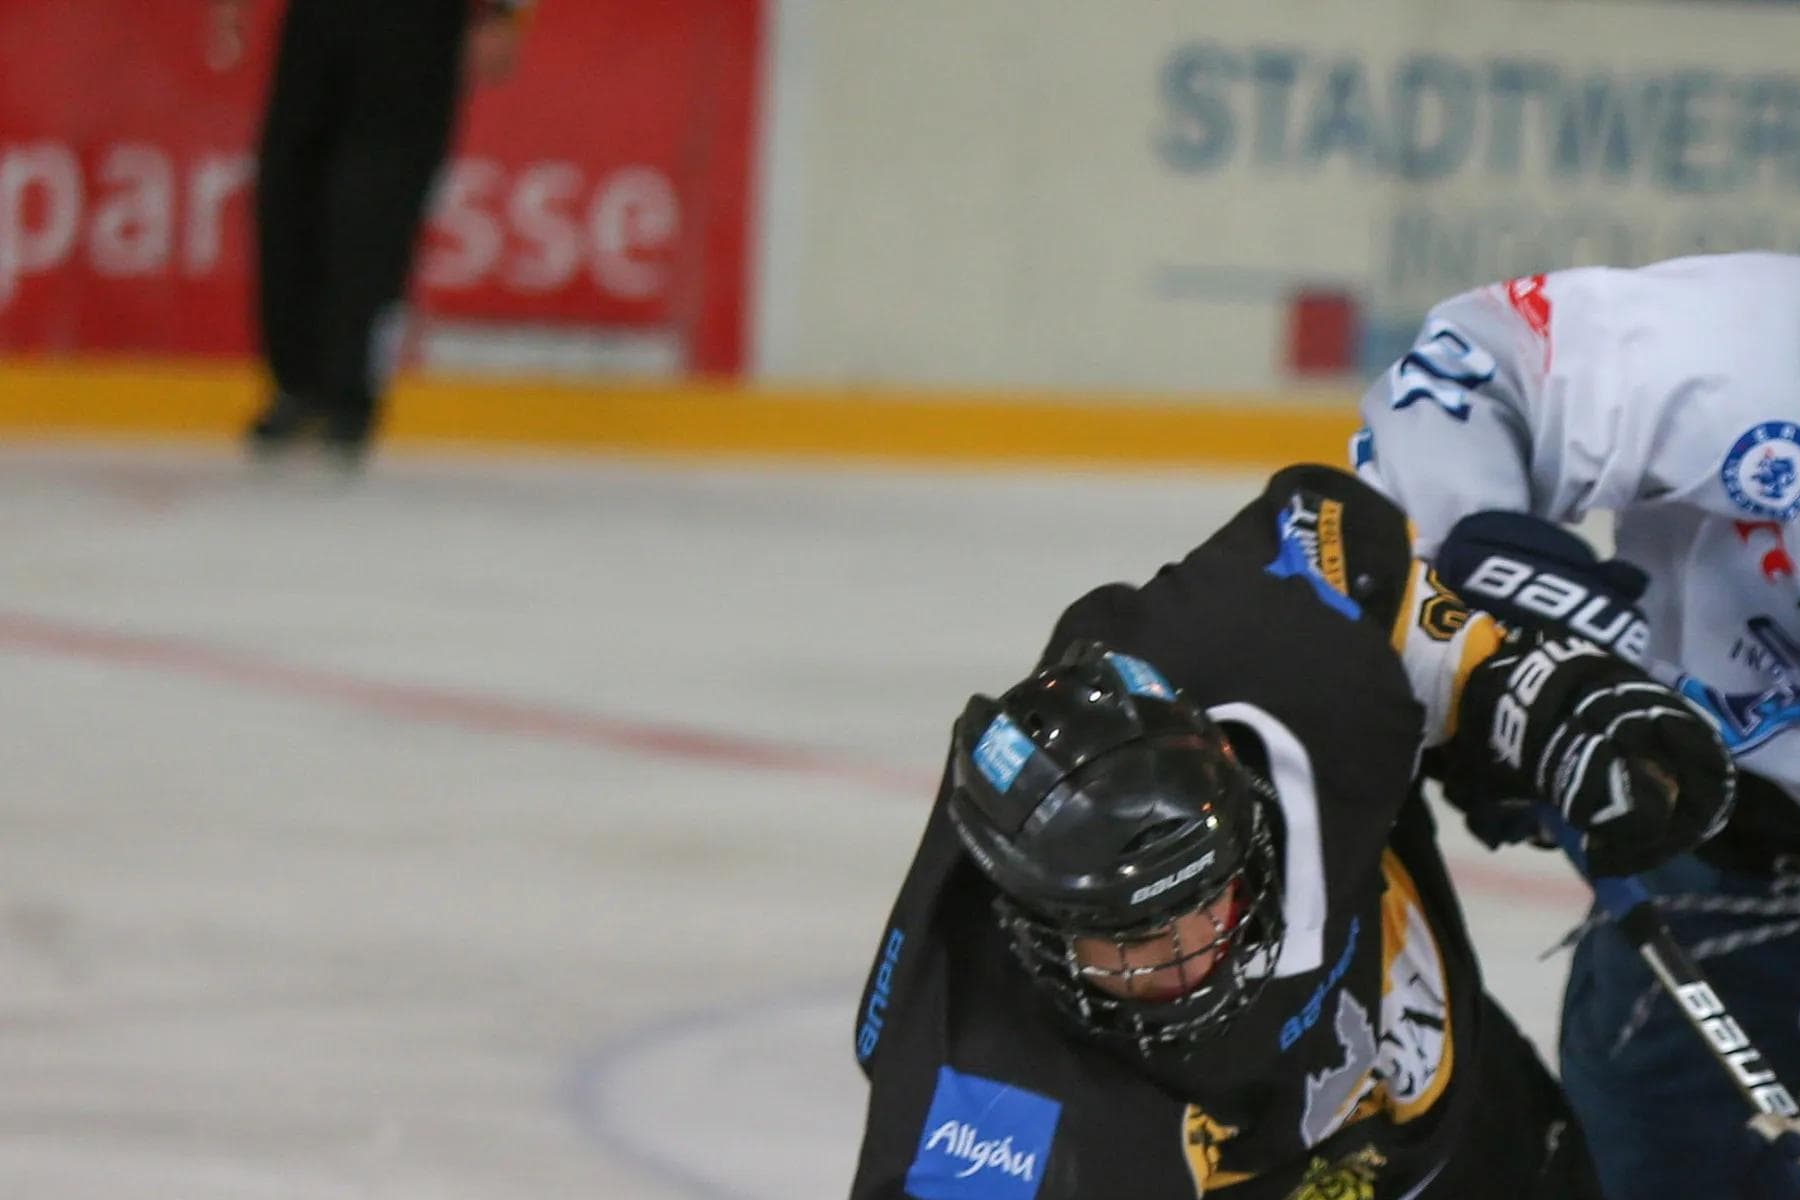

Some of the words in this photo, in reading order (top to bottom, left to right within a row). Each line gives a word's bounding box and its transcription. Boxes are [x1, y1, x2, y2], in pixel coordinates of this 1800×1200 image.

[0, 138, 682, 305] parsse
[1463, 555, 1651, 662] BAUE
[1676, 979, 1800, 1118] BAUE
